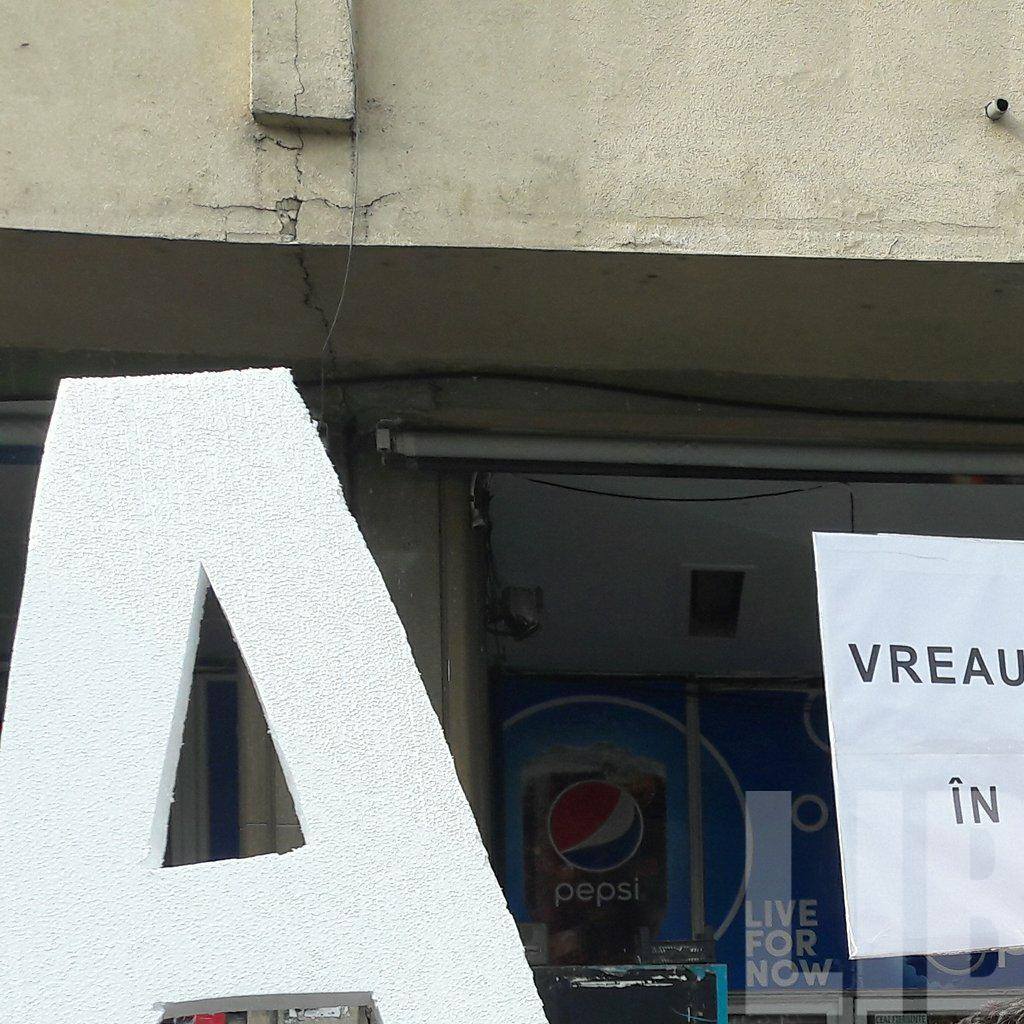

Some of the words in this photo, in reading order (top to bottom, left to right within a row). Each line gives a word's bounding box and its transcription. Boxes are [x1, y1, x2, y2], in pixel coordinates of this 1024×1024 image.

[948, 777, 1000, 825] ÎN
[555, 876, 640, 908] pepsi
[745, 898, 819, 928] LIVE
[745, 928, 818, 958] FOR
[745, 958, 833, 988] NOW
